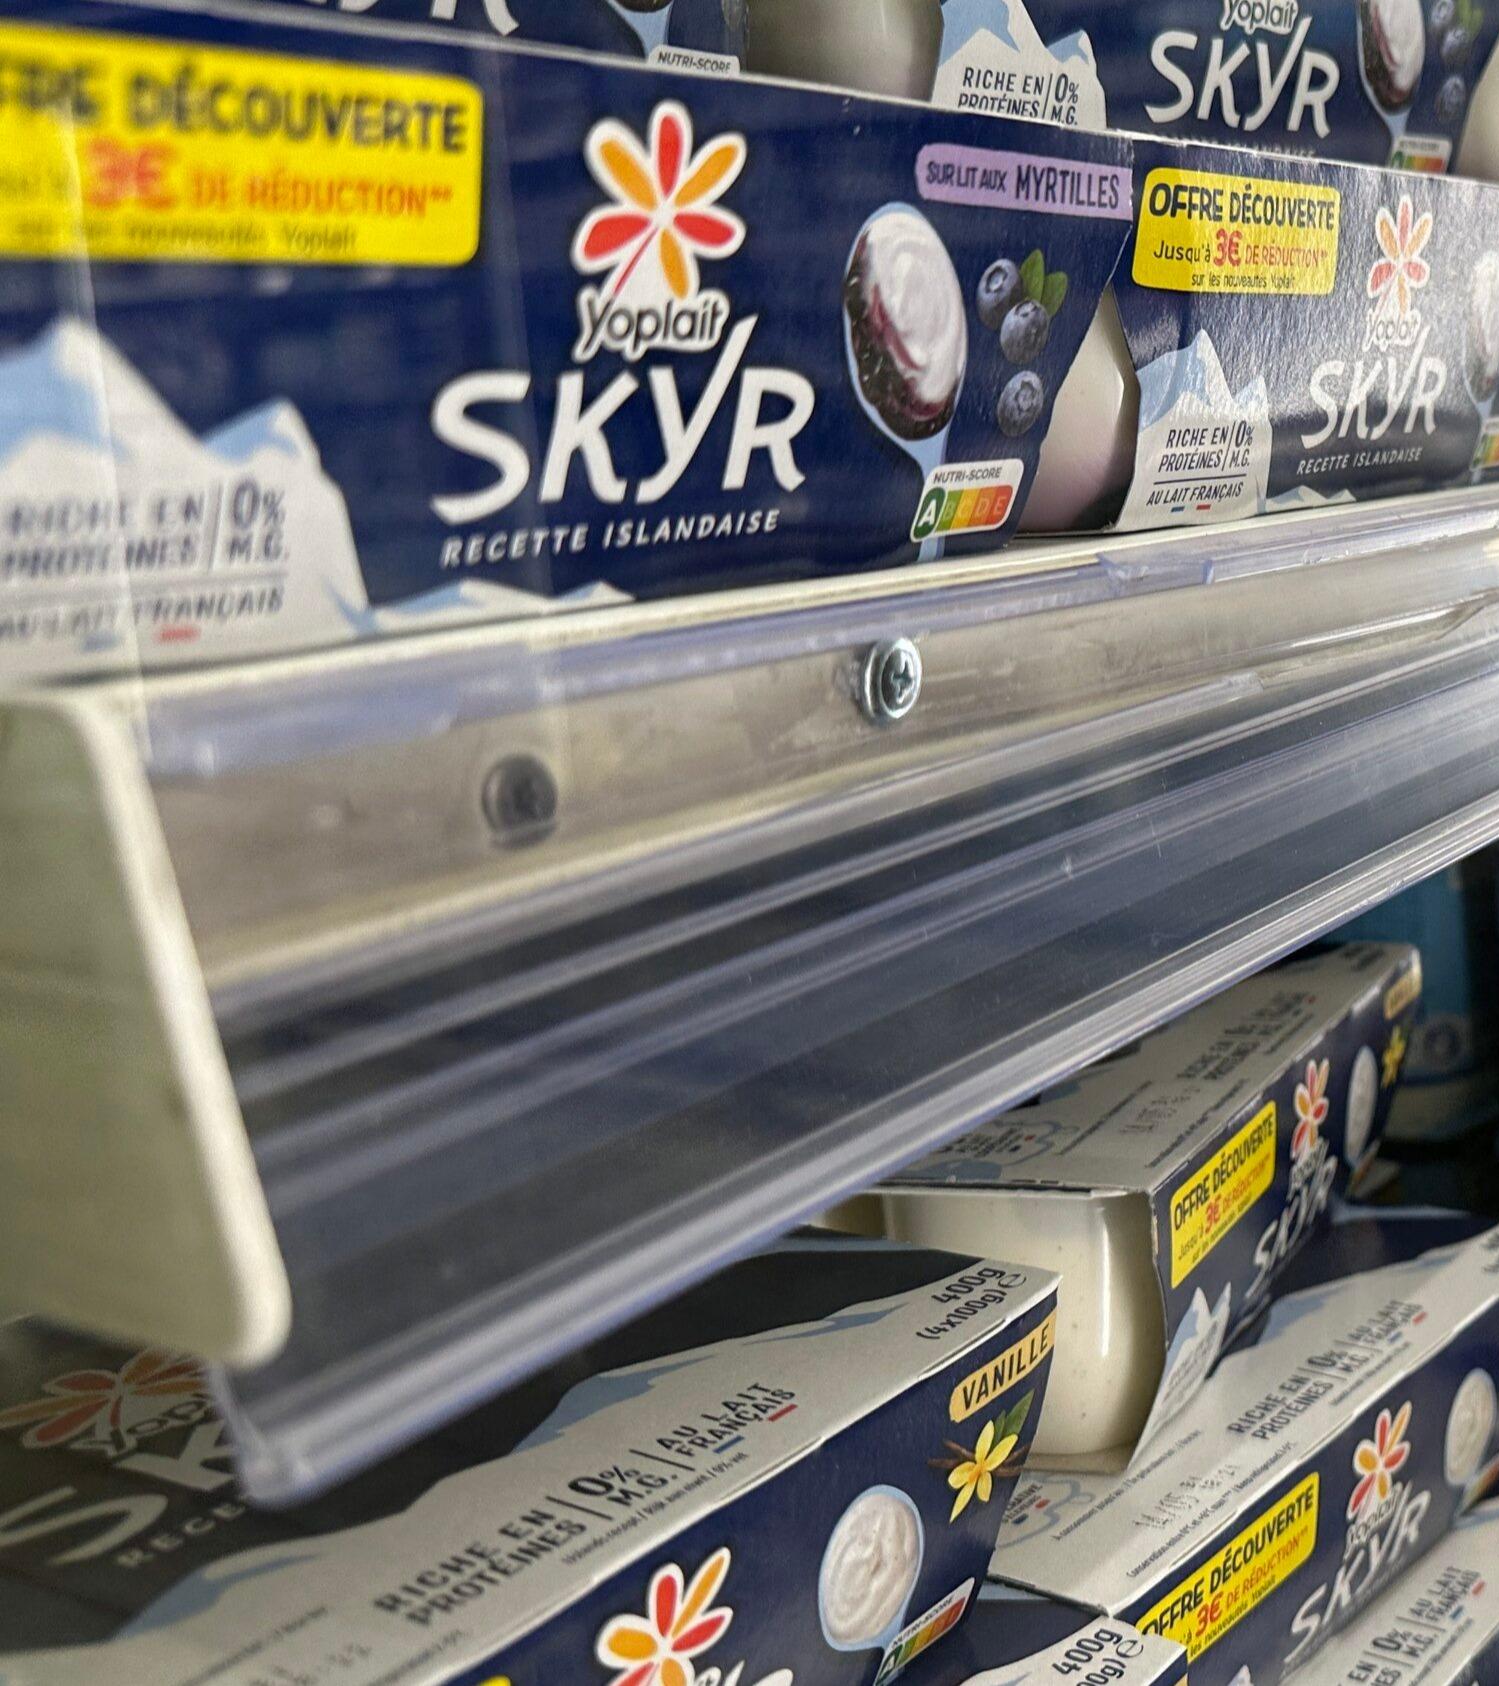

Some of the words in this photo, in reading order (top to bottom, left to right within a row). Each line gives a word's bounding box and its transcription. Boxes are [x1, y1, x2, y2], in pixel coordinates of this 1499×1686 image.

[1224, 0, 1297, 31] Yoplait
[658, 51, 733, 74] NUTRI-SCORE
[962, 67, 1016, 92] RICHE
[1023, 74, 1045, 96] EN
[1054, 73, 1080, 104] 0%
[1145, 16, 1340, 139] SKYR
[127, 60, 469, 154] DÉCOUVERTE
[1051, 106, 1078, 126] M.G.
[88, 138, 178, 212] 3€
[926, 161, 956, 186] SUR
[956, 166, 978, 187] LIT
[980, 170, 1007, 193] AUX
[1015, 165, 1119, 210] MYRTILLES
[1149, 183, 1224, 223] OFFRE
[1229, 184, 1335, 231] DÉCOUVERTE
[1153, 240, 1211, 264] Jusqu'à
[1213, 228, 1243, 267] 3€
[1245, 245, 1258, 265] DE
[1191, 274, 1204, 285] sur
[1209, 273, 1220, 286] les
[1224, 274, 1267, 287] nouveautés
[581, 296, 723, 352] Yoplait
[1301, 325, 1447, 449] SKYR
[430, 313, 815, 524] SKYR
[1166, 428, 1208, 448] RICHE
[1211, 426, 1229, 445] EN
[1235, 420, 1255, 448] 0%
[933, 467, 1002, 484] NUTRI-SCORE
[1158, 448, 1223, 472] PROTÉINES
[1230, 449, 1250, 469] M.G.
[1296, 454, 1350, 475] RECETTE
[1353, 448, 1422, 468] ISLANDAISE
[232, 475, 287, 530] 0%
[1146, 490, 1163, 506] AU
[1163, 488, 1190, 503] LAIT
[1190, 482, 1244, 502] FRANÇAIS
[441, 524, 588, 569] RECETTE
[603, 508, 780, 549] ISLANDAISE
[1174, 1174, 1210, 1231] OFFRE
[1213, 1113, 1274, 1191] DÉCOUVERTE
[1205, 1193, 1222, 1235] 3€
[931, 1267, 1006, 1304] 400g
[916, 1288, 1008, 1340] (4x100g)
[962, 1322, 1050, 1411] VANILLE
[656, 1424, 699, 1451] AU
[701, 1382, 772, 1423] LAIT
[675, 1388, 796, 1457] FRANÇAIS
[1227, 1393, 1284, 1435] RICHE
[1280, 1374, 1311, 1394] EN
[607, 1473, 679, 1507] M.G.
[373, 1540, 495, 1613] RICHE
[498, 1509, 556, 1540] EN
[568, 1465, 641, 1497] 0%
[1142, 1577, 1205, 1637] OFFRE
[1209, 1484, 1315, 1594] DÉCOUVERTE
[1283, 1480, 1431, 1664] SKYR
[1409, 1598, 1431, 1617] AU
[1428, 1566, 1462, 1595] LAIT
[1195, 1590, 1225, 1637] 3€
[1226, 1591, 1240, 1609] DE
[1052, 1628, 1123, 1675] 400g
